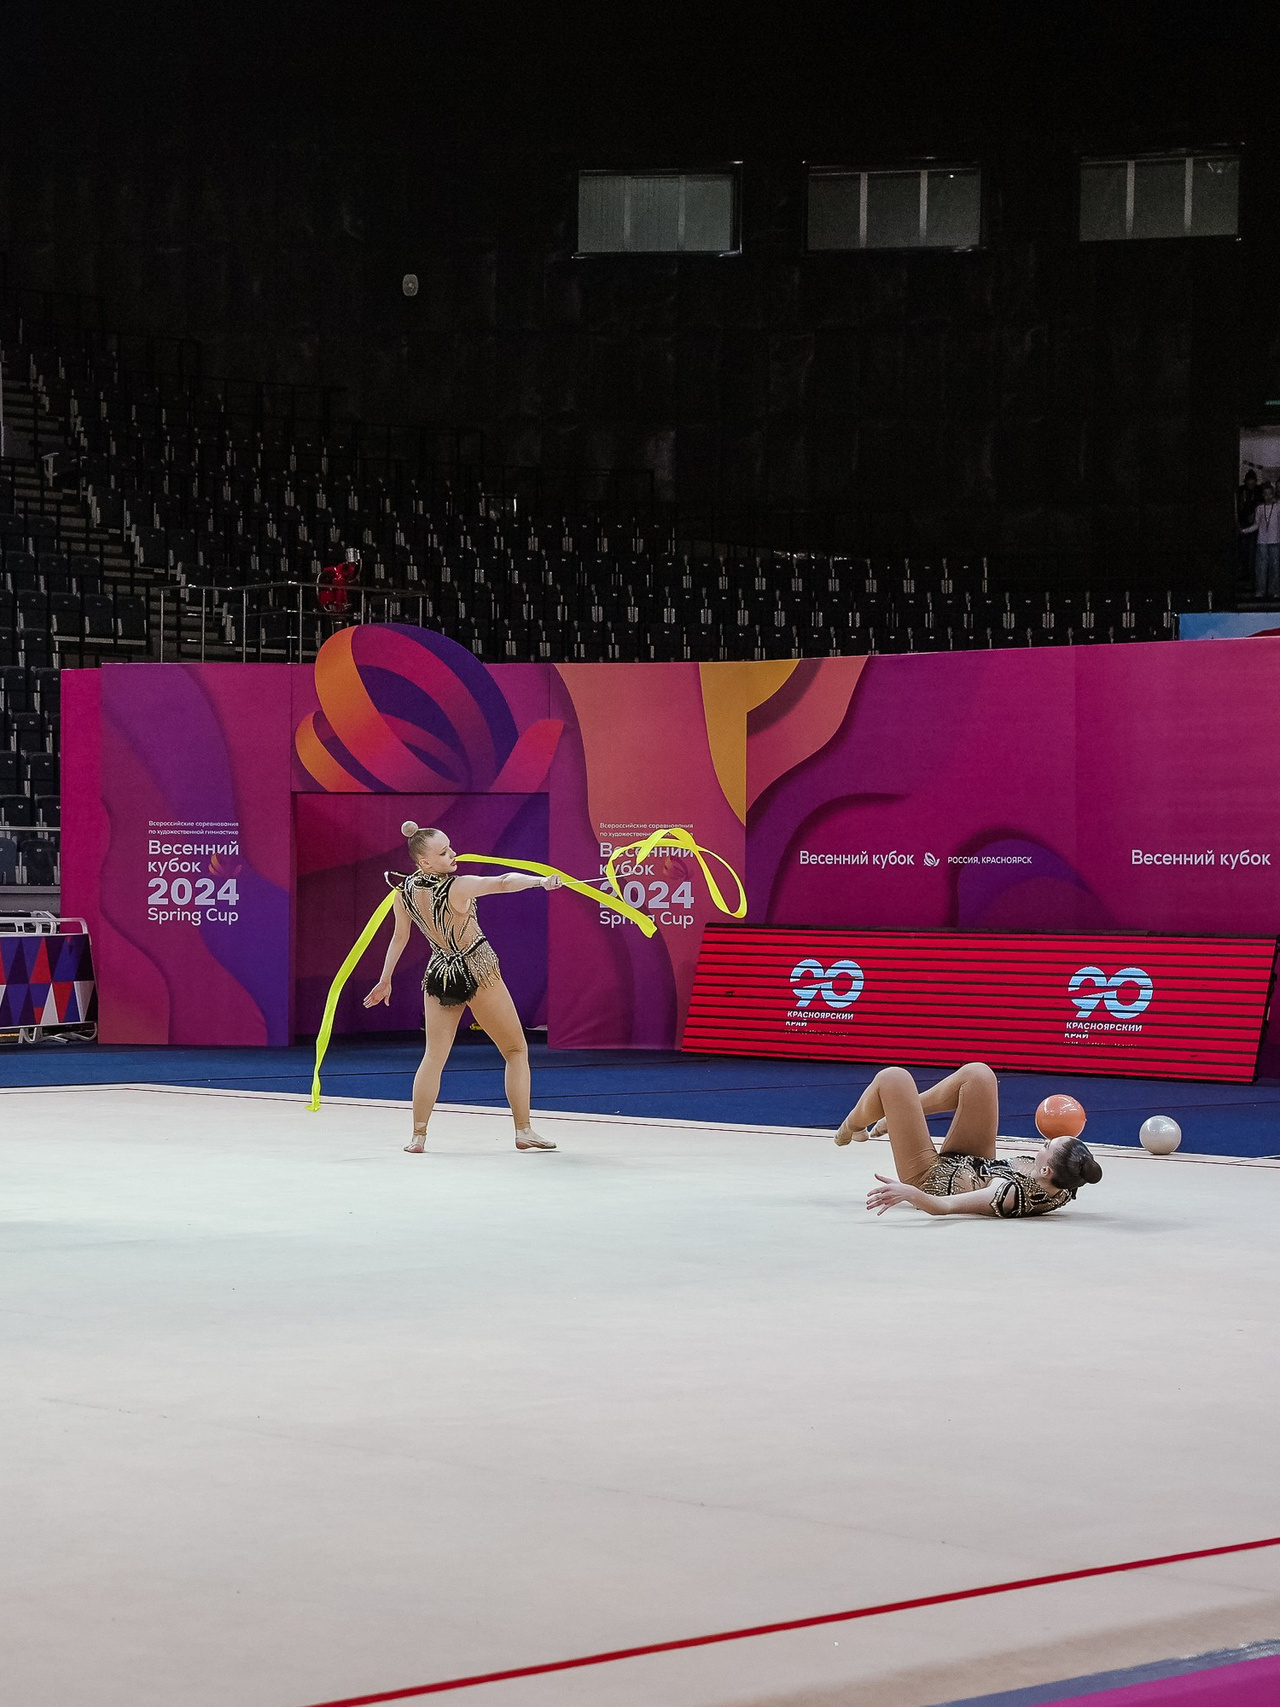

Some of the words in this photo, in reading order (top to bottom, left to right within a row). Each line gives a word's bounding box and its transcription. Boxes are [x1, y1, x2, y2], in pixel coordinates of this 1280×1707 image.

[148, 820, 195, 828] Всероссийские
[148, 840, 239, 855] Весенний
[148, 857, 201, 877] кубок
[799, 850, 869, 865] Весенний
[872, 850, 915, 869] кубок
[947, 856, 980, 865] РОССИЯ,
[981, 856, 1033, 865] КРАСНОЯРСК
[1131, 849, 1216, 866] Весенний
[1220, 849, 1272, 870] кубок
[147, 877, 240, 906] 2024
[147, 907, 202, 926] Spring
[206, 908, 239, 925] Cup
[660, 911, 694, 929] Cup
[789, 958, 865, 1008] 90
[1067, 966, 1154, 1019] 90
